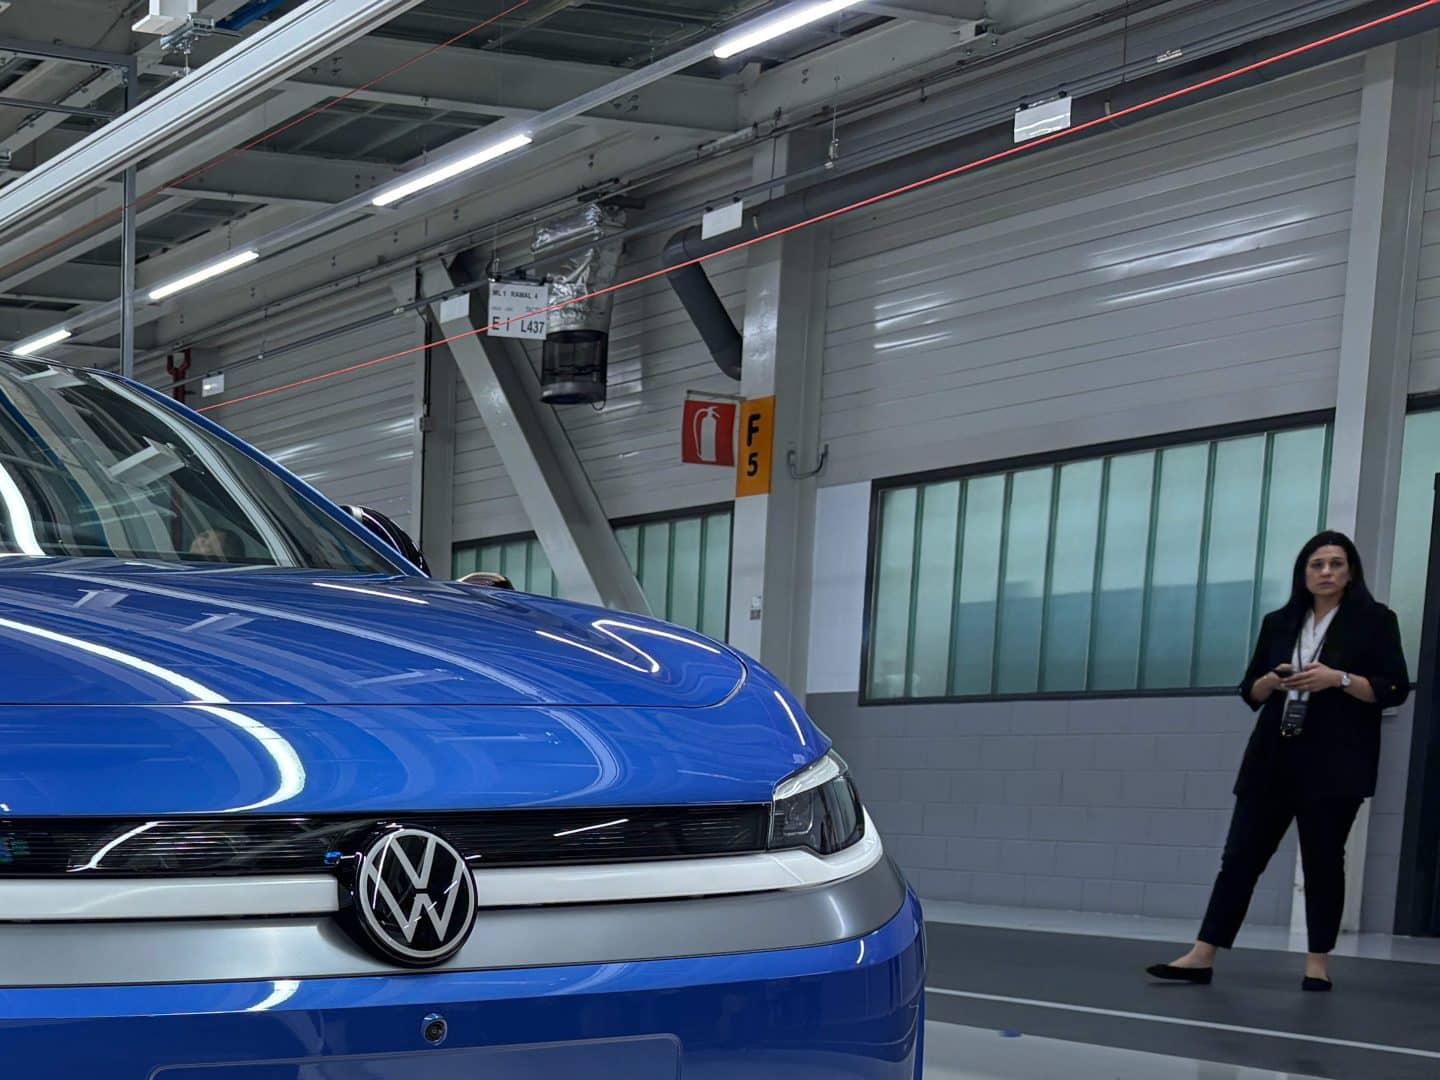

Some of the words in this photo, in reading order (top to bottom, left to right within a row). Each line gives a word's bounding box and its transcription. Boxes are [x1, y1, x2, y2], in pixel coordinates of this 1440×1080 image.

[521, 319, 545, 334] L437
[747, 412, 761, 447] F
[747, 452, 758, 477] 5
[363, 833, 468, 947] VW
